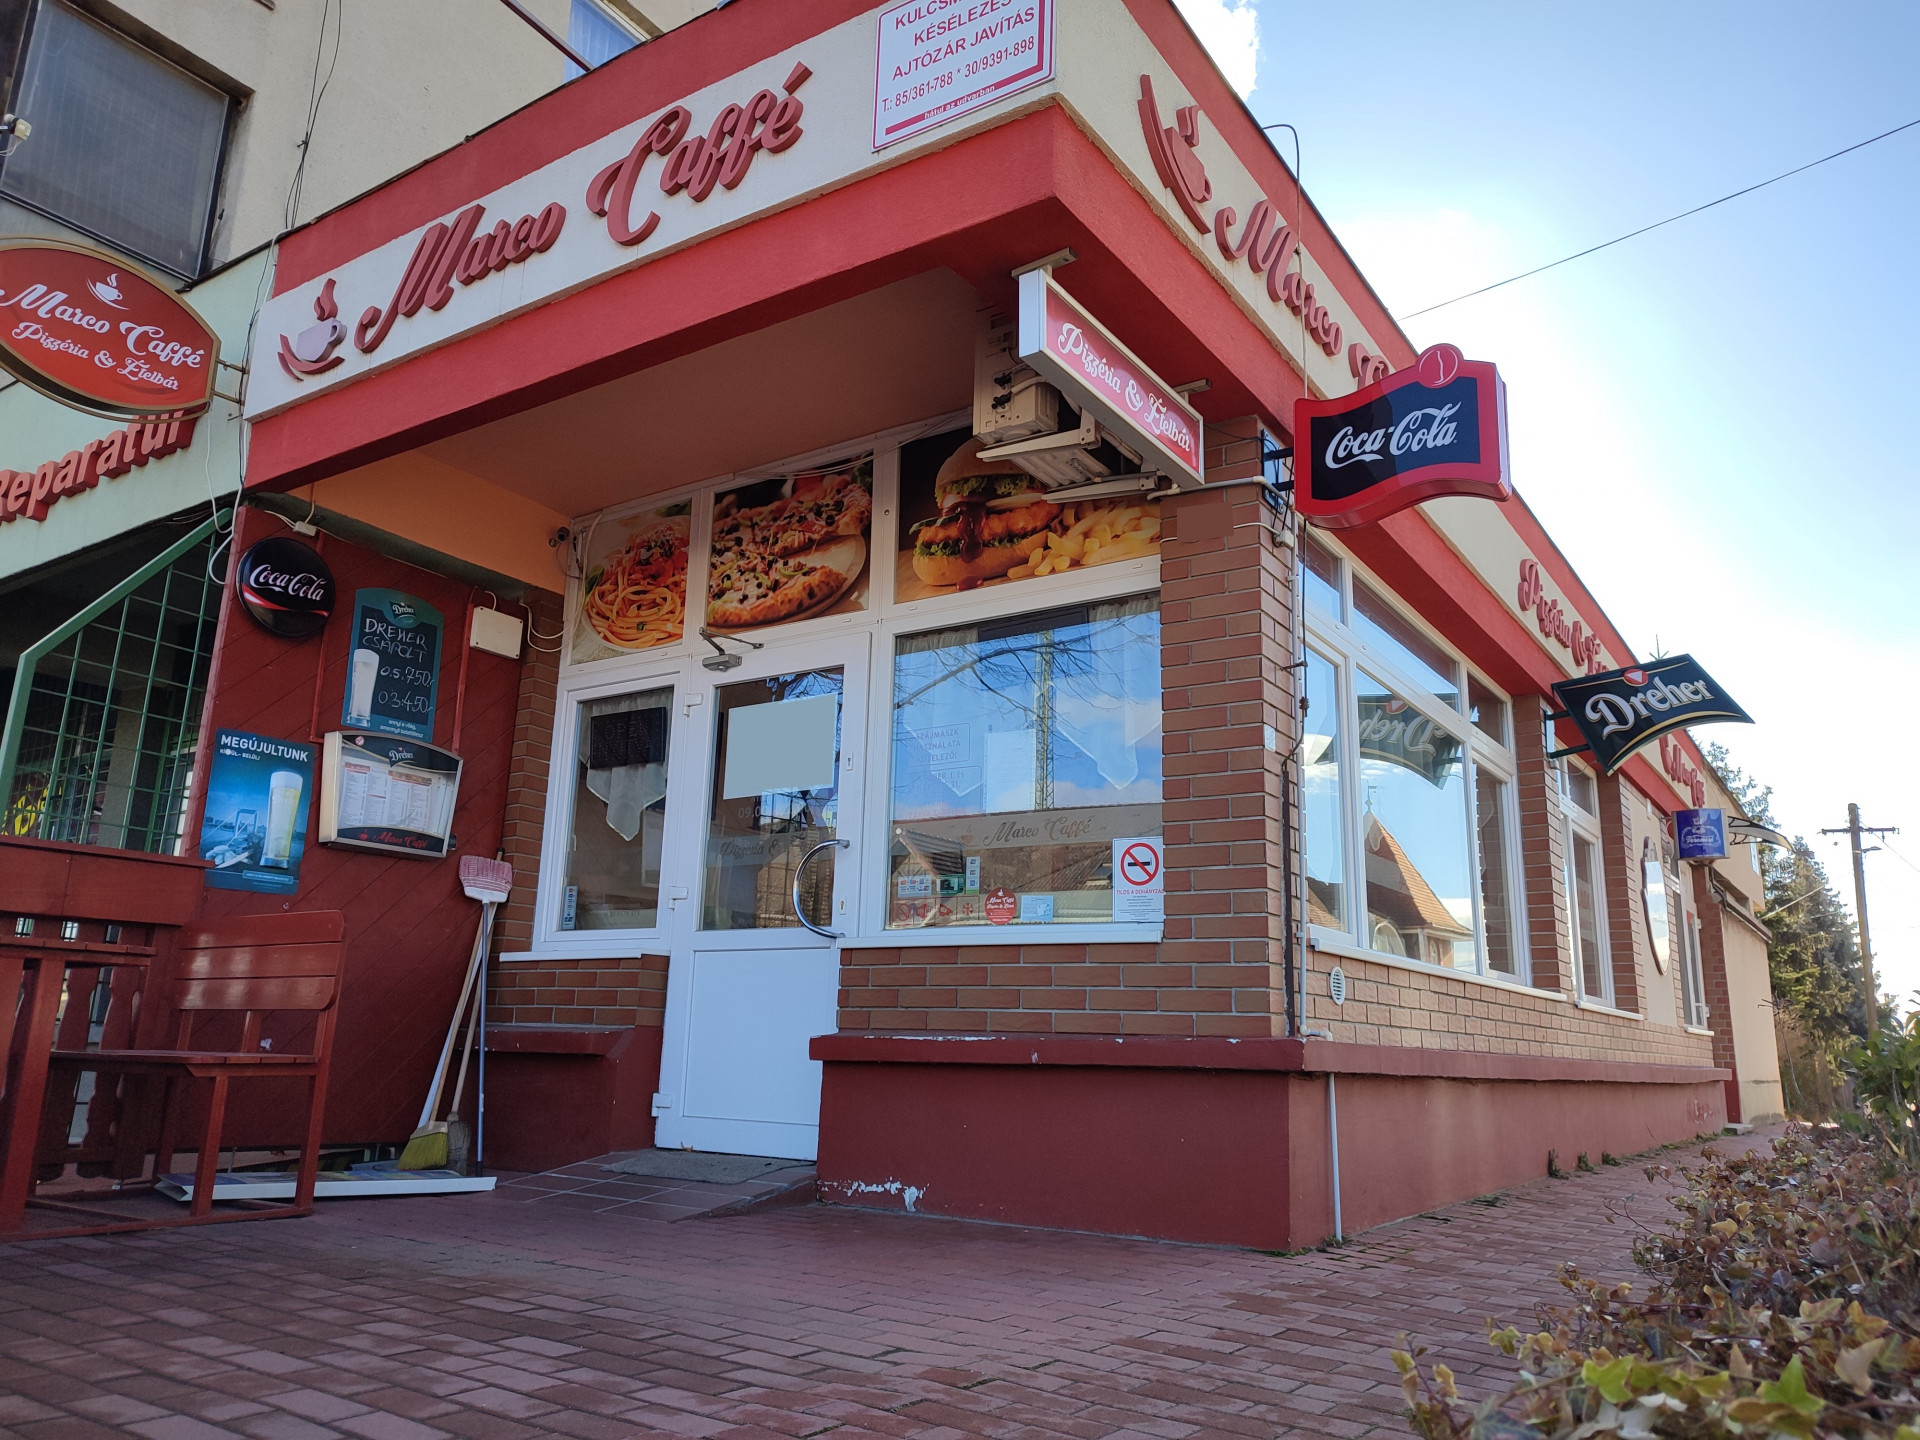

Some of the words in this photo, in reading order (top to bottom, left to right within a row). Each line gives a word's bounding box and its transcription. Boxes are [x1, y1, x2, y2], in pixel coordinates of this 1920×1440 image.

[892, 37, 967, 82] AJTÓZÁR
[970, 6, 1035, 47] JAVÍTÁS
[894, 71, 953, 107] 85/361-788
[964, 36, 1035, 78] 30/9391-898
[946, 101, 956, 110] az
[353, 202, 567, 354] Marco
[585, 60, 813, 247] Caffé
[1214, 199, 1344, 358] Marco
[0, 283, 111, 334] Marco
[119, 320, 205, 368] Caffé
[11, 321, 90, 359] Pizzéria
[93, 350, 117, 369] &
[116, 356, 179, 391] Ételbár
[1057, 322, 1121, 394] Pizzéria
[1124, 379, 1144, 412] &
[1143, 392, 1191, 452] Ételbár
[1324, 401, 1462, 470] Coca-Cola
[249, 564, 328, 601] Coca-Cola
[392, 603, 415, 615] Dreher
[363, 617, 428, 651] DREHER
[1584, 675, 1716, 741] Dreher
[220, 734, 310, 762] MEGÚJULTUNK
[982, 821, 1040, 847] Marco
[1043, 815, 1096, 841] Caffé
